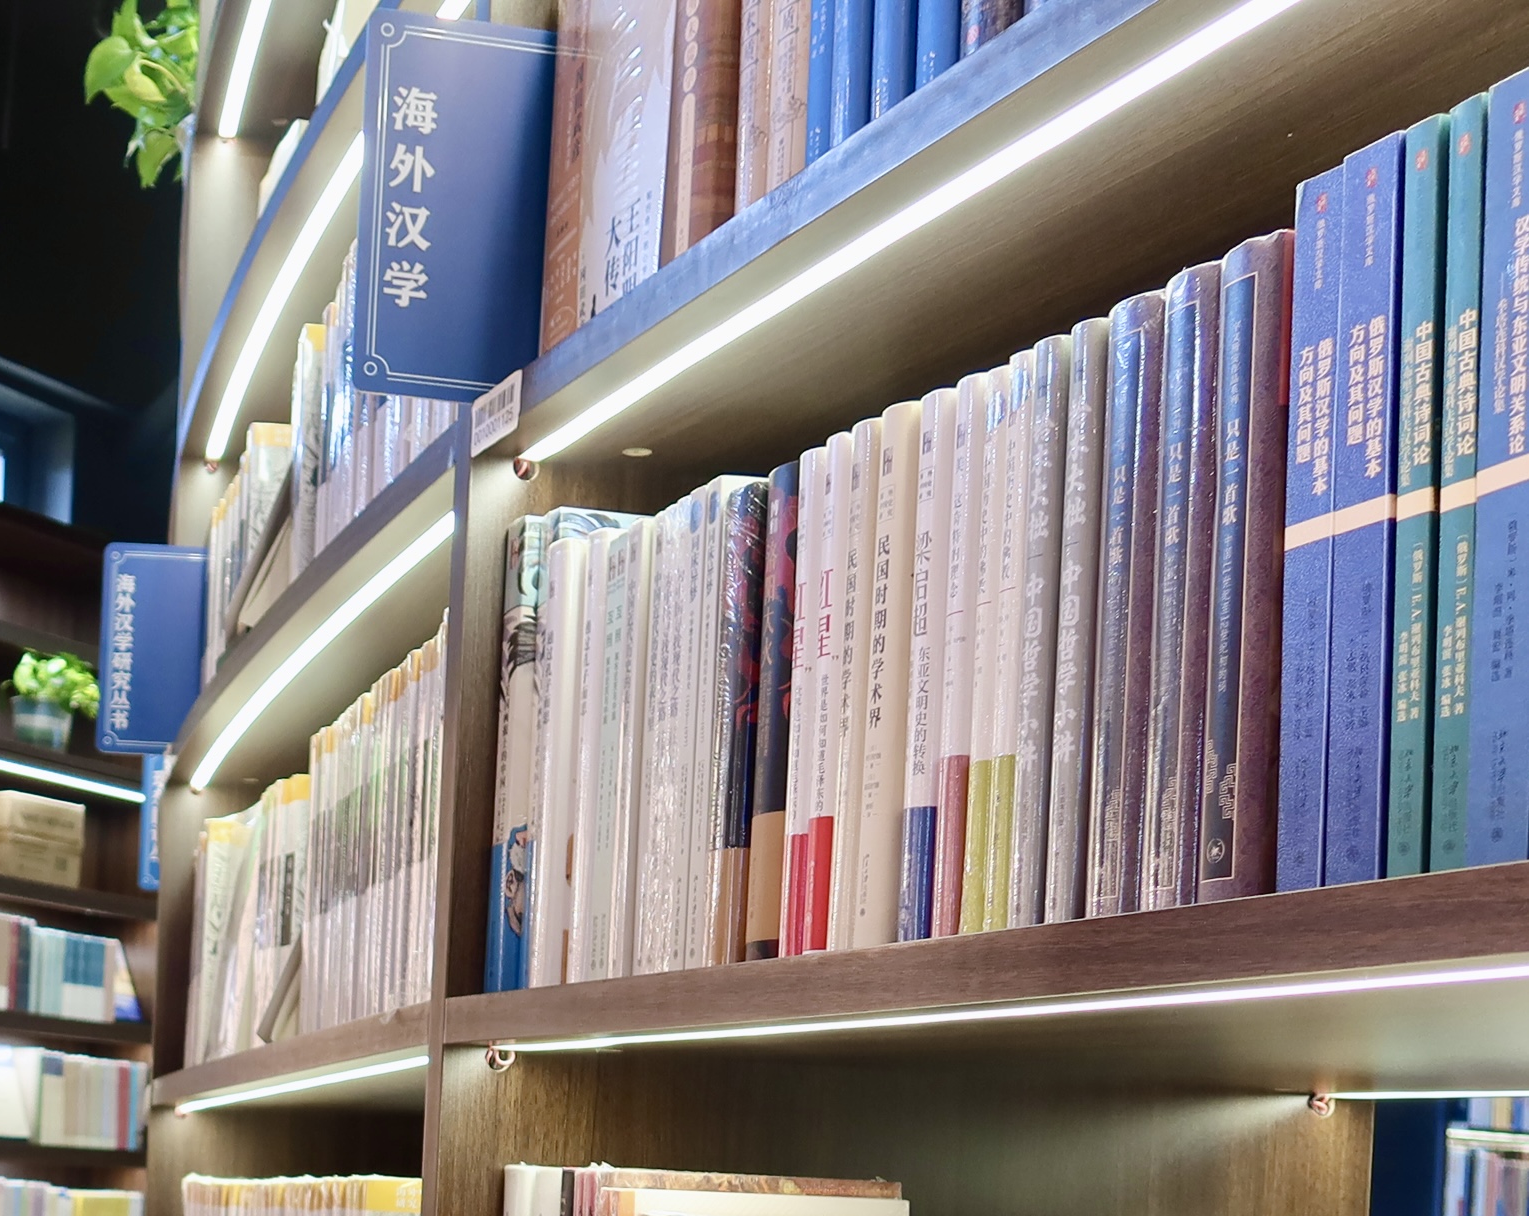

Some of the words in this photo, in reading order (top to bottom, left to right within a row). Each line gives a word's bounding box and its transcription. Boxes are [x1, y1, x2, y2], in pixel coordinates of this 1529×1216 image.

[382, 86, 438, 309] 海外汉学
[1295, 344, 1315, 466] 方向及其问题
[1311, 337, 1335, 498] 俄罗斯汉学的基本
[1345, 322, 1366, 448] 方向及其问题
[1364, 314, 1387, 480] 俄罗斯汉学的基本
[1412, 319, 1434, 467] 中国古典诗词论
[1456, 307, 1479, 457] 中国古典诗词论
[1164, 441, 1183, 546] 只是一首歌
[1222, 417, 1241, 525] 只是一首歌
[110, 573, 138, 731] 海外汉学研究丛书
[838, 547, 858, 739] 民国时期的学术界
[868, 533, 891, 731] 民国时期的学术界
[911, 646, 931, 776] 东亚文明史的转换
